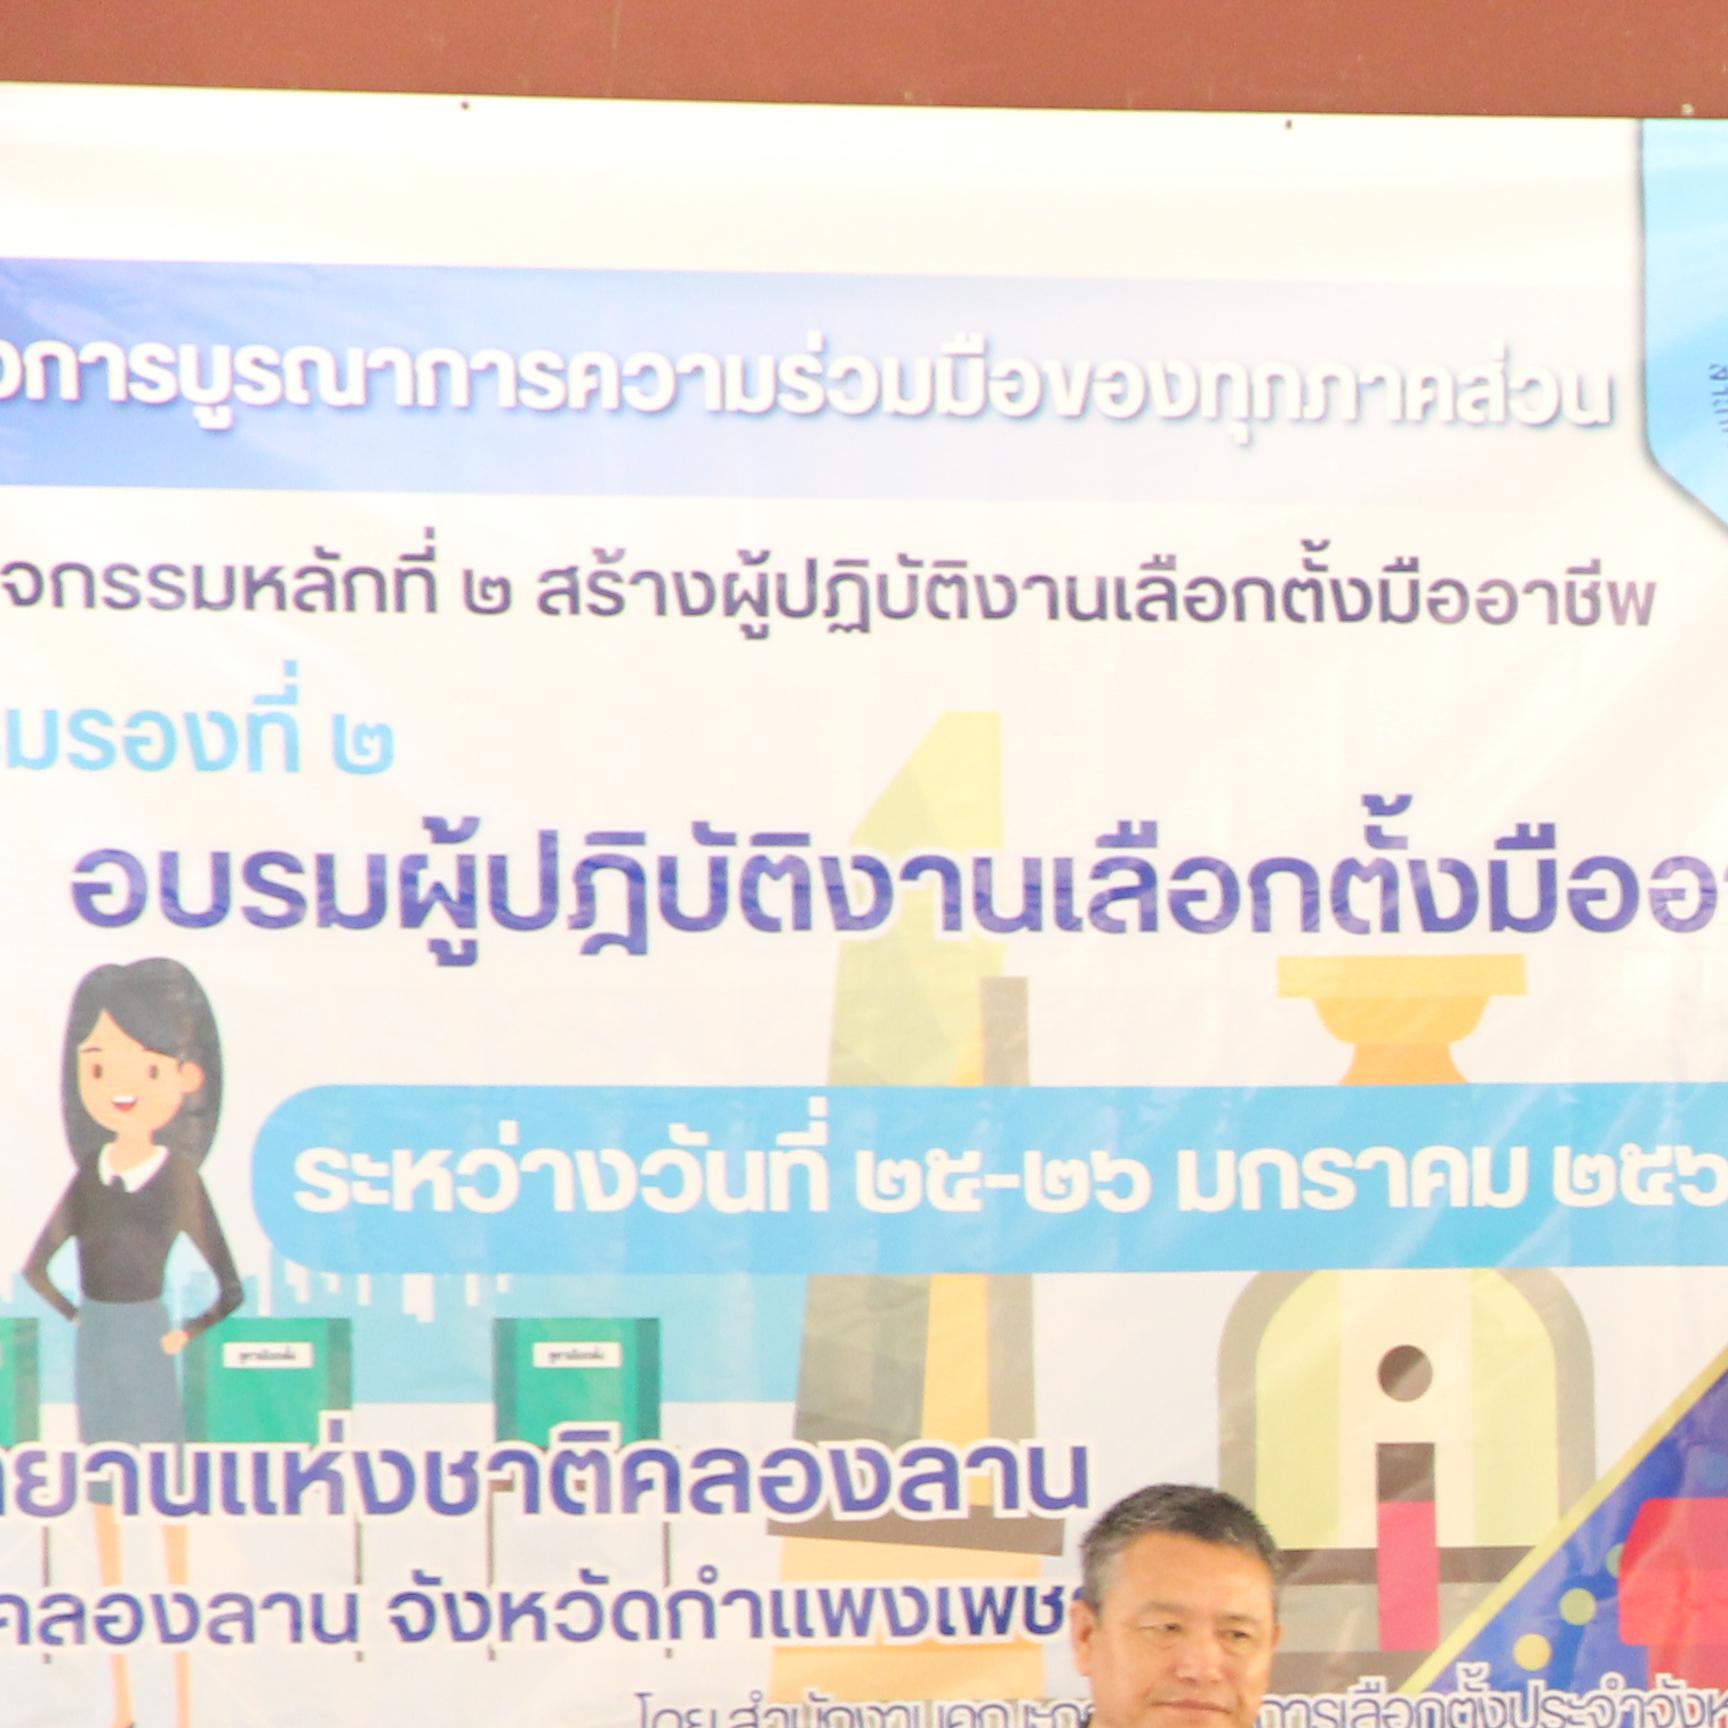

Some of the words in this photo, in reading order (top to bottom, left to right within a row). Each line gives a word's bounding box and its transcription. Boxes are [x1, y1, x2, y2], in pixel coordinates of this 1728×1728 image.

[0, 526, 437, 614] จกรรมหลักที่
[462, 568, 512, 615] ๒
[537, 540, 1658, 640] สร้างผู้ปฏิบัติงานเลือกตั้งมืออาชีพ
[5, 659, 300, 773] มรองที่
[331, 712, 394, 775] ๒
[294, 1096, 829, 1214] ระหว่างวันที่
[855, 1147, 1151, 1214] ๒๕-๒๖
[1178, 1145, 1528, 1213] มกราคม
[0, 1418, 1088, 1517] ยานแห่งชาติคลองลาน
